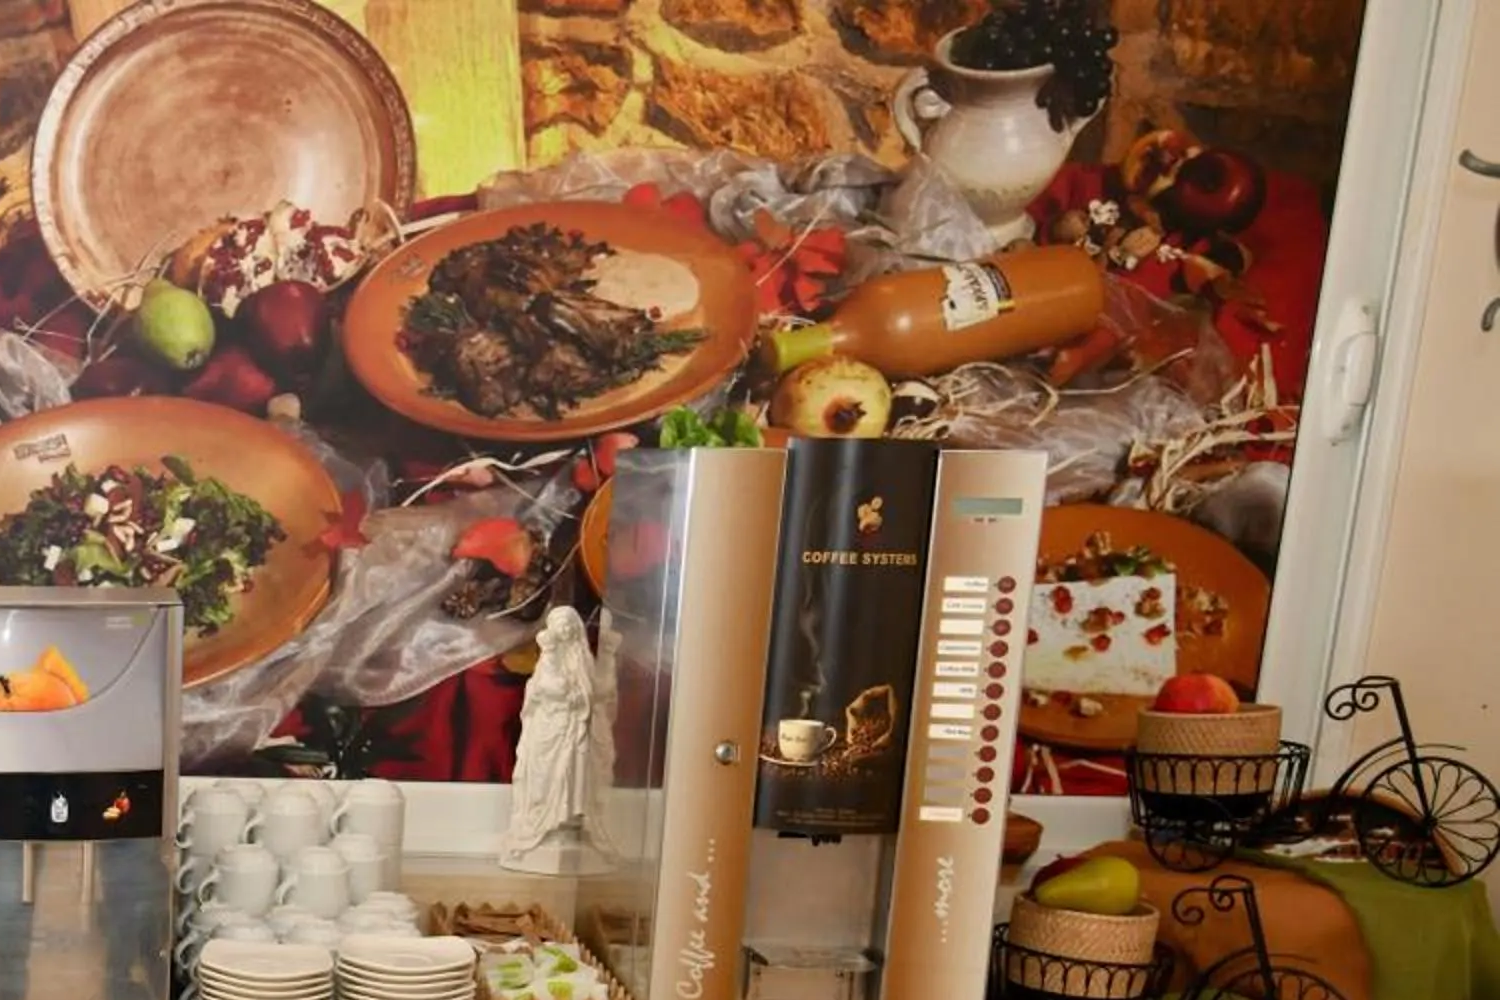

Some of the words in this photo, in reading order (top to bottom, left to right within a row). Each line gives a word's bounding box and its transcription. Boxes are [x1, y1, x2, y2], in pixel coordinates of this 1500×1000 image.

[802, 550, 858, 565] COFFEE
[686, 870, 712, 923] and
[675, 927, 716, 999] Coffee
